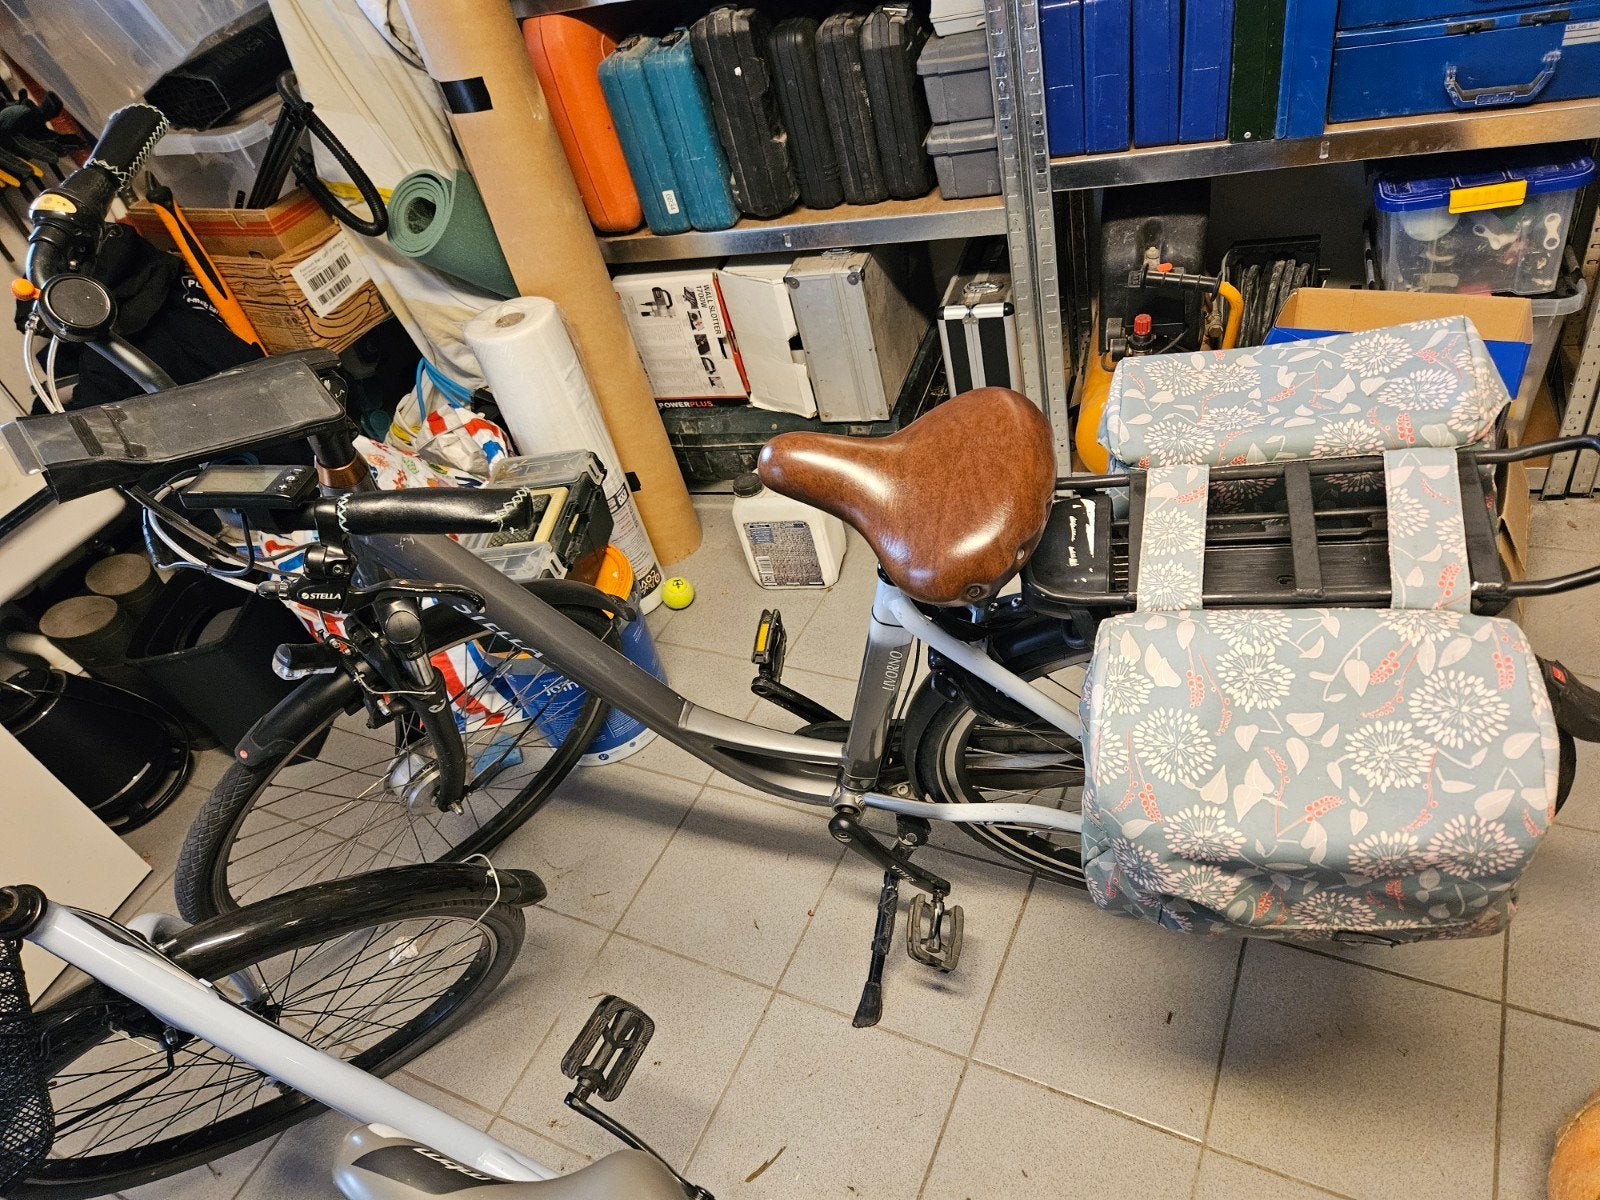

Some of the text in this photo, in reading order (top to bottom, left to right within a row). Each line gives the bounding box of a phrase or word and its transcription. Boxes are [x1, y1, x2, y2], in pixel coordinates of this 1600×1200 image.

[696, 285, 708, 309] 1700W
[703, 284, 722, 335] WALL SLOTTER
[658, 401, 713, 409] POWERPLUS
[310, 592, 342, 600] STELLA
[882, 650, 903, 691] LIVORNO
